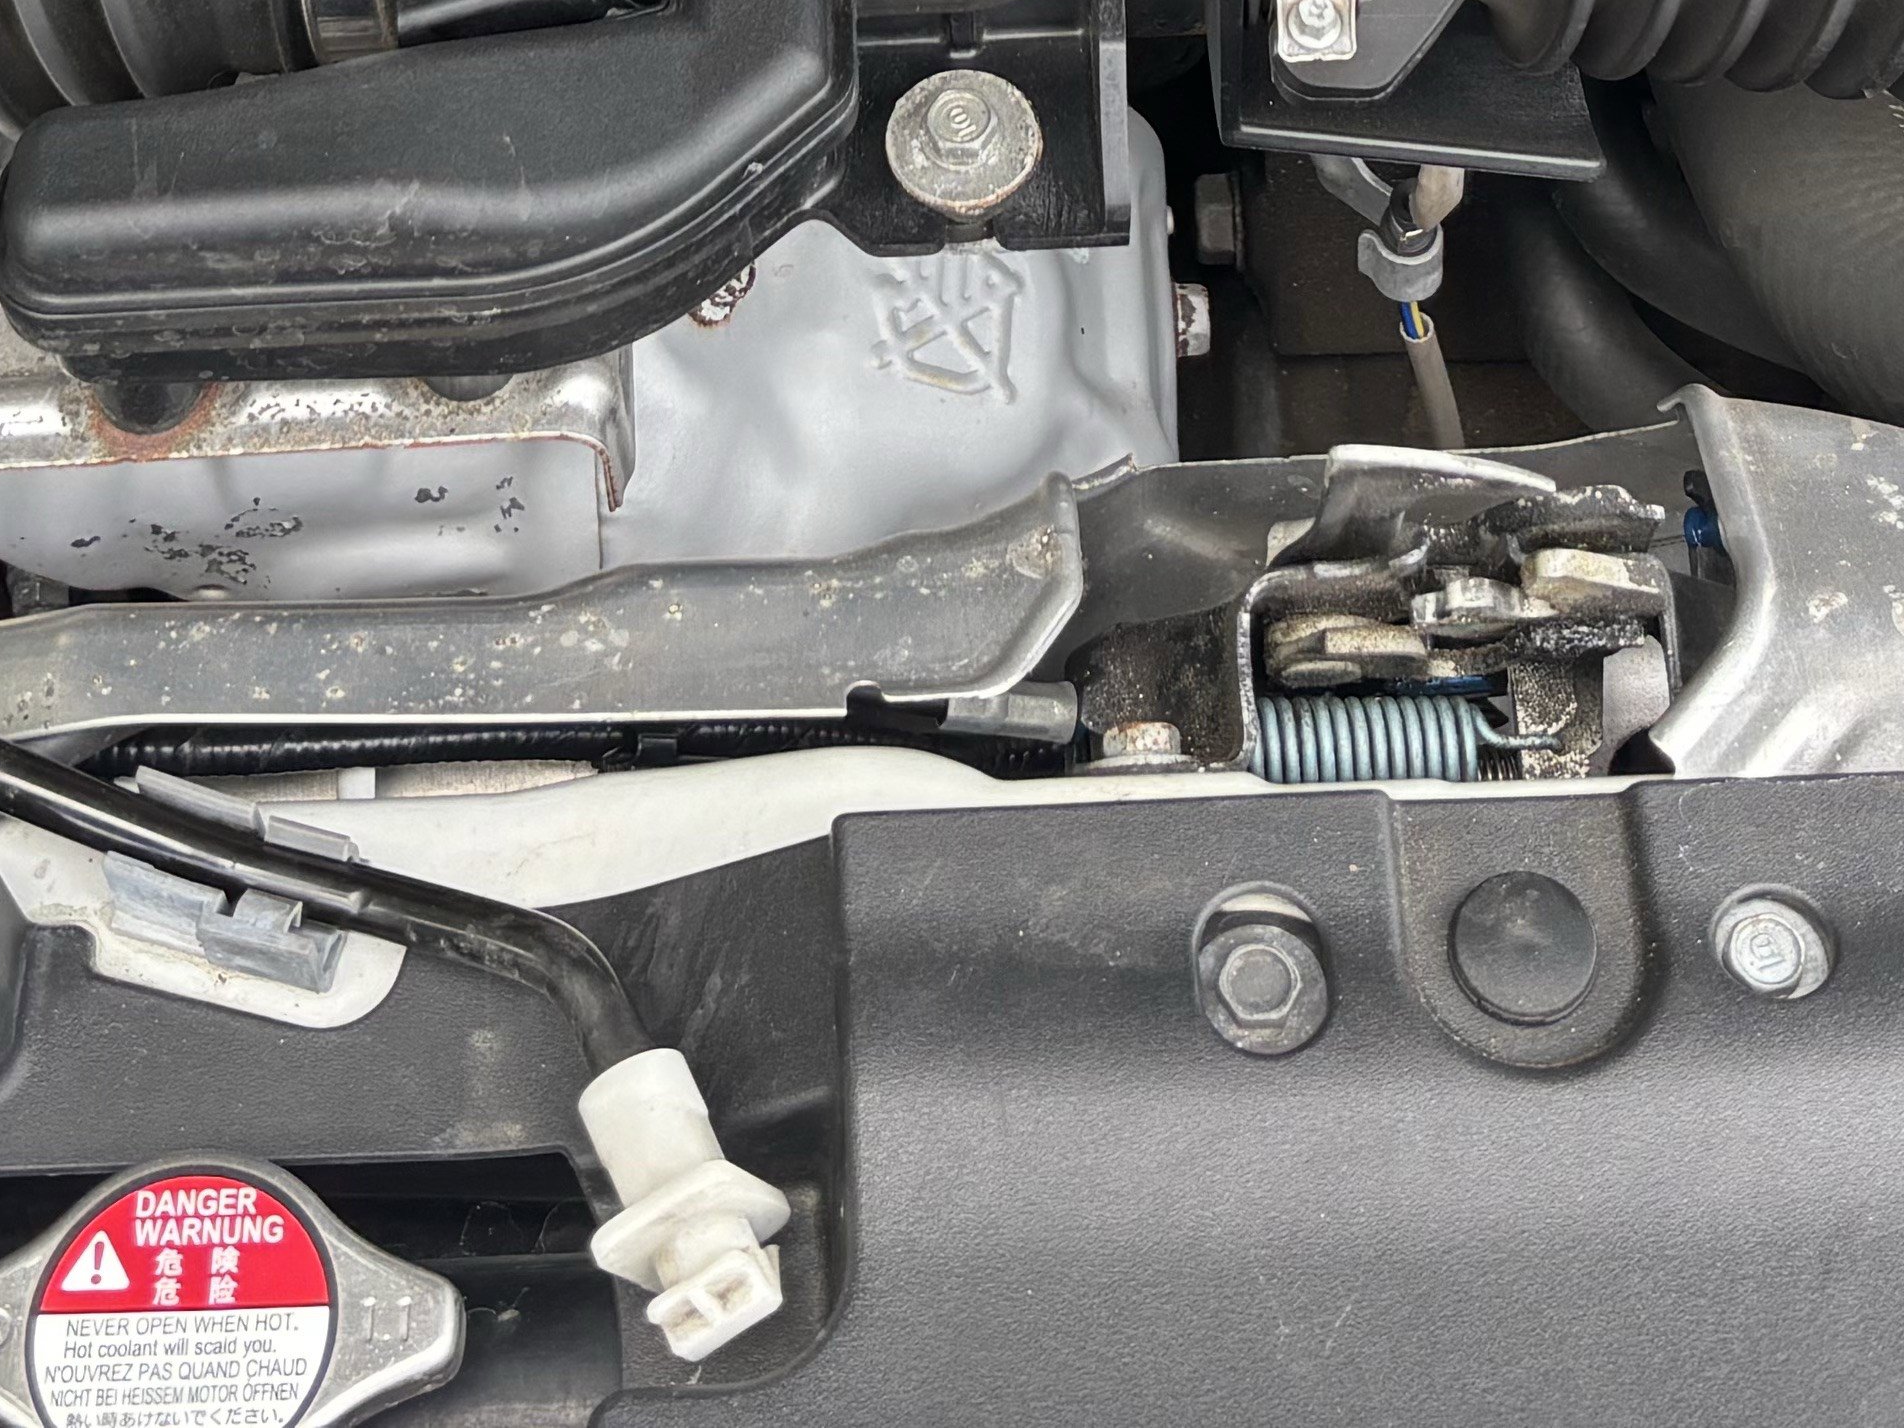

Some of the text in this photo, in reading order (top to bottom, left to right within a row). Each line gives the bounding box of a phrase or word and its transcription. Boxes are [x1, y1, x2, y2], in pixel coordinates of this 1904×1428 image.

[135, 1187, 258, 1218] DANGER
[134, 1215, 285, 1246] WARNUNG
[66, 1312, 299, 1337] NEVER OPEN WHEN HOT.
[64, 1337, 277, 1360] Hot coolant will scald you.
[44, 1362, 134, 1384] N'OUVREZ
[138, 1361, 173, 1382] PAS
[178, 1360, 241, 1381] QUAND
[50, 1388, 92, 1408] NICHT
[96, 1387, 118, 1407] BEI
[122, 1385, 185, 1406] HEISSEM
[187, 1384, 238, 1404] MOTOR
